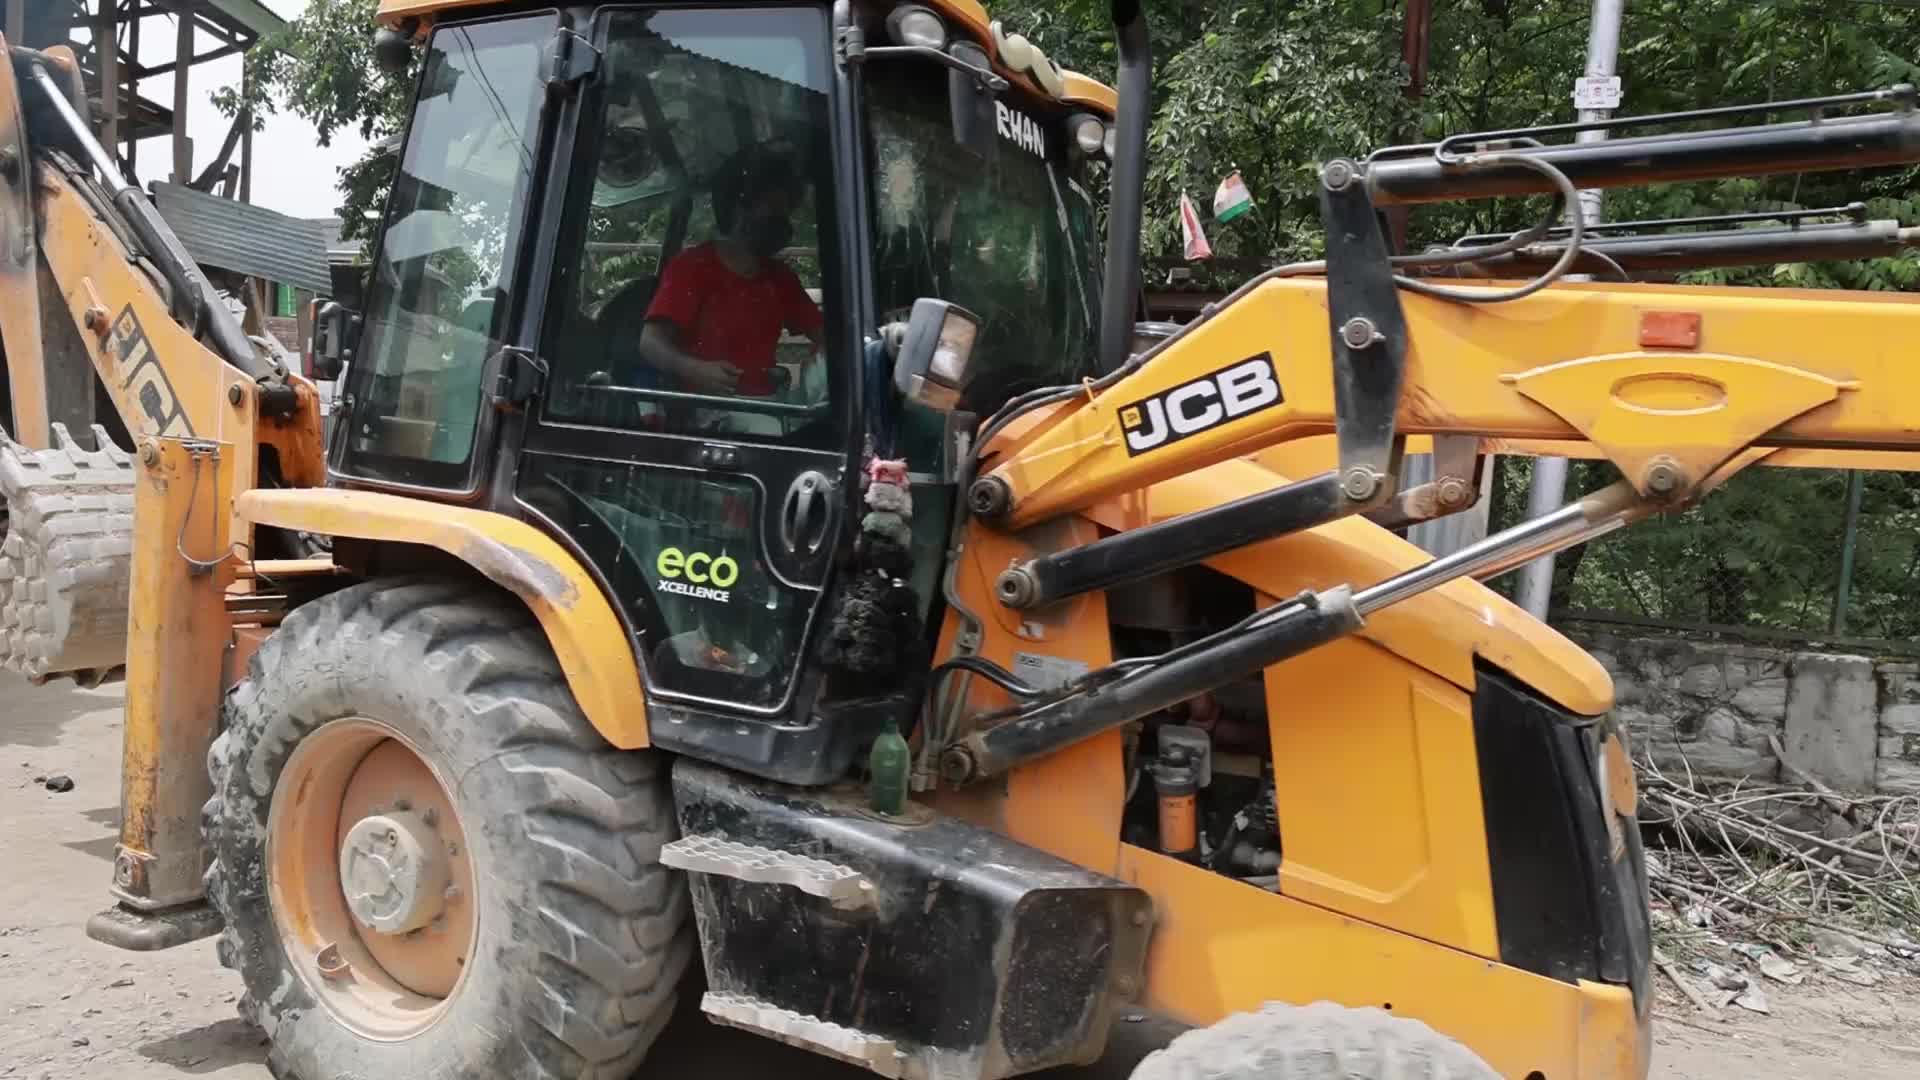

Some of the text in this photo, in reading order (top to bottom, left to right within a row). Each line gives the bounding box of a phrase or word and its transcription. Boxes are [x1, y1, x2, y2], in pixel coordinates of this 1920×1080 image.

[1127, 359, 1279, 450] JCB
[657, 547, 739, 587] eco
[658, 580, 730, 603] XCELLENCE
